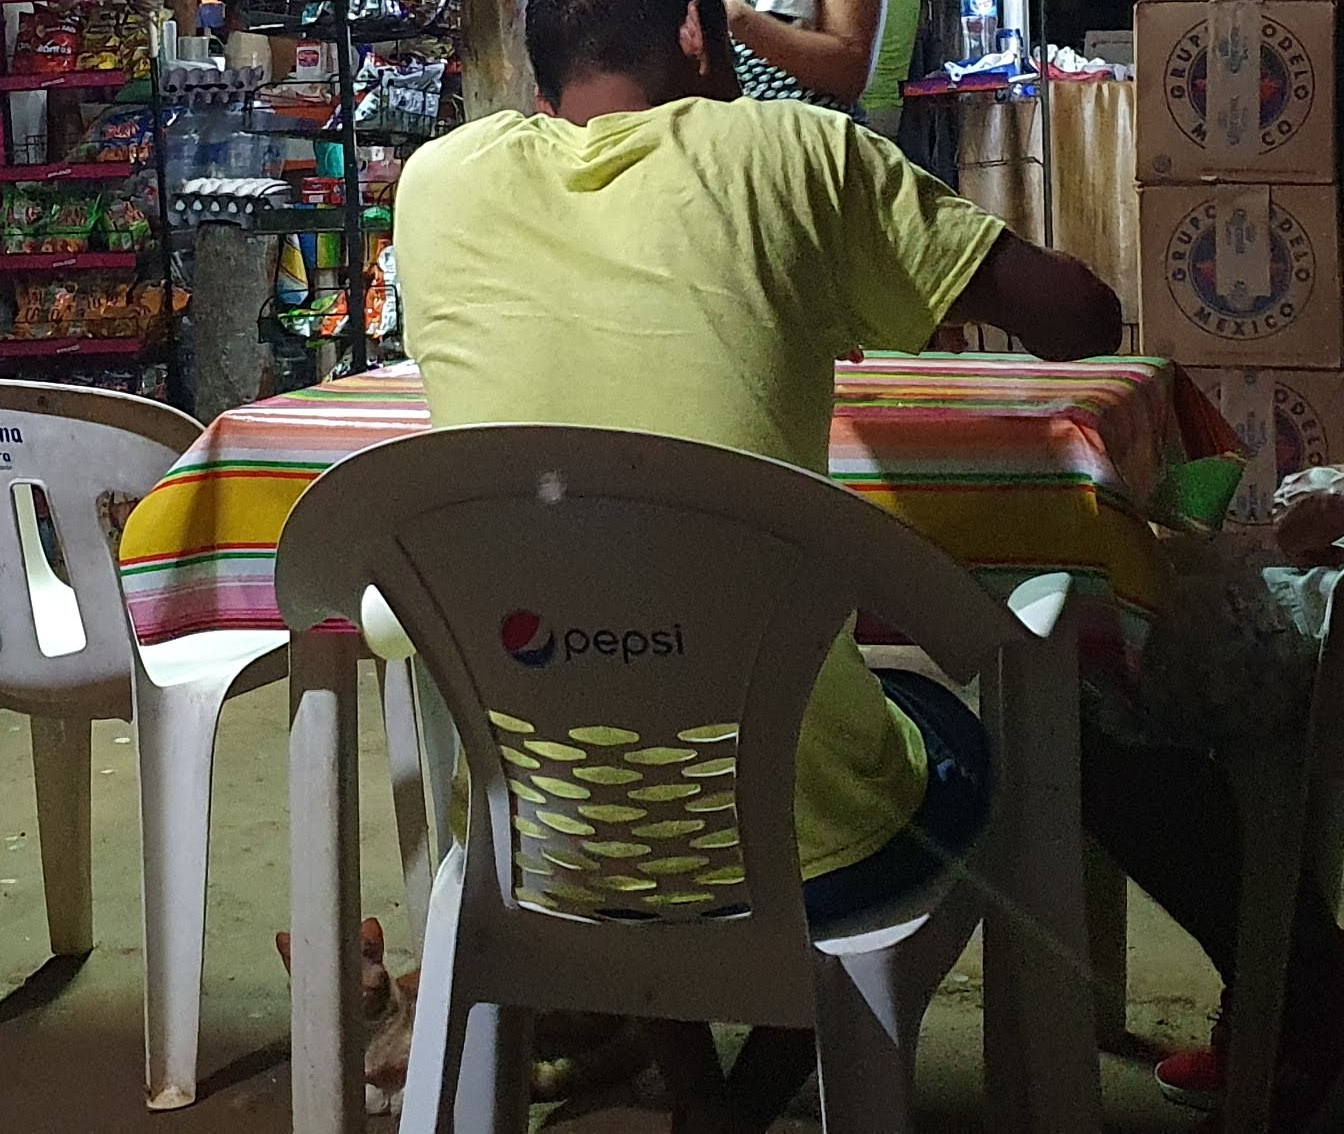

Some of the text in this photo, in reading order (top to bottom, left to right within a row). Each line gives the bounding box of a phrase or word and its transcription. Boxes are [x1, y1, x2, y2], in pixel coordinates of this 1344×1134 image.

[1170, 25, 1208, 99] GRUP
[1261, 23, 1310, 101] ODELO
[1194, 302, 1295, 337] MEXICO
[1273, 387, 1323, 467] ODELO
[564, 623, 684, 664] pepsi
